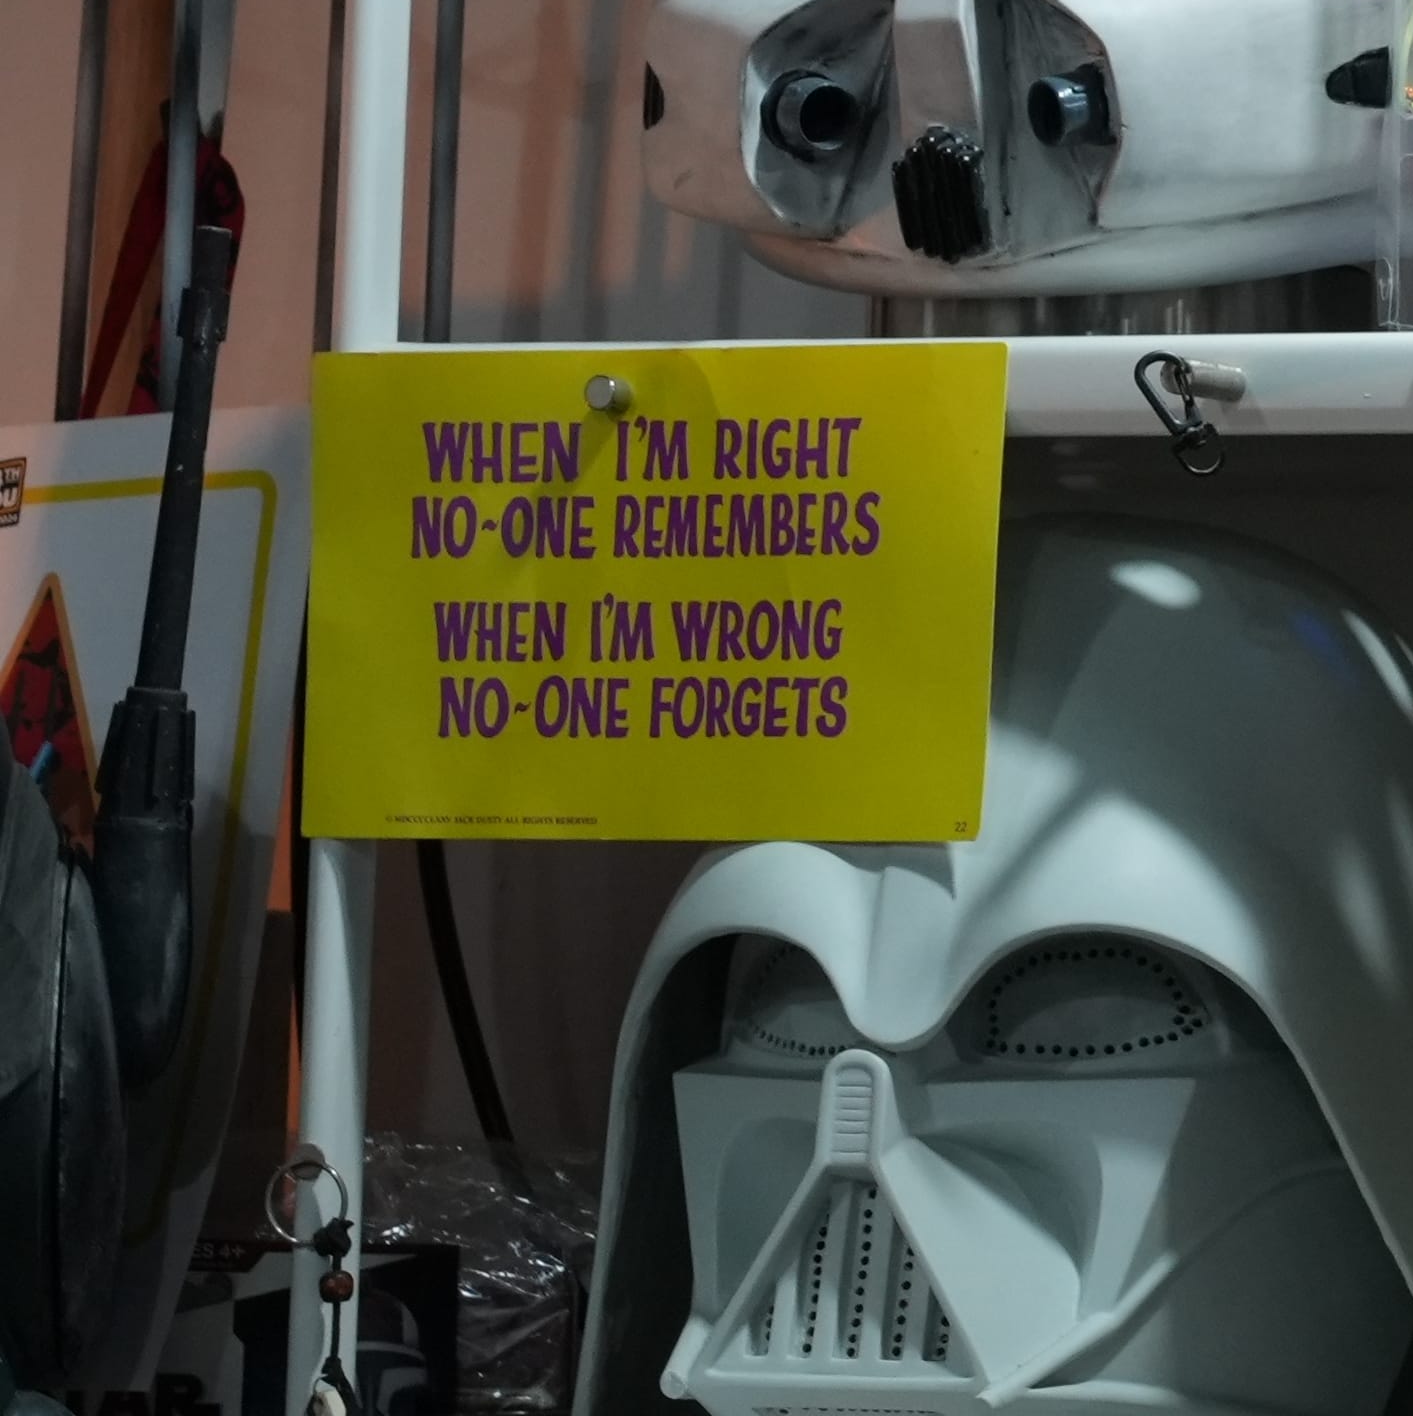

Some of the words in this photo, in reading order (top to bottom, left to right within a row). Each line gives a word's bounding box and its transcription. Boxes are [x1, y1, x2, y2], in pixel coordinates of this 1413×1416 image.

[422, 422, 582, 482] WHEN
[616, 415, 689, 480] I'M
[714, 417, 862, 479] RIGHT
[613, 491, 881, 557] REMEMBERS
[434, 601, 567, 661] WHEN
[590, 593, 655, 661] I'M
[671, 598, 843, 661] WRONG
[649, 675, 848, 738] FORGETS
[954, 820, 968, 833] 22
